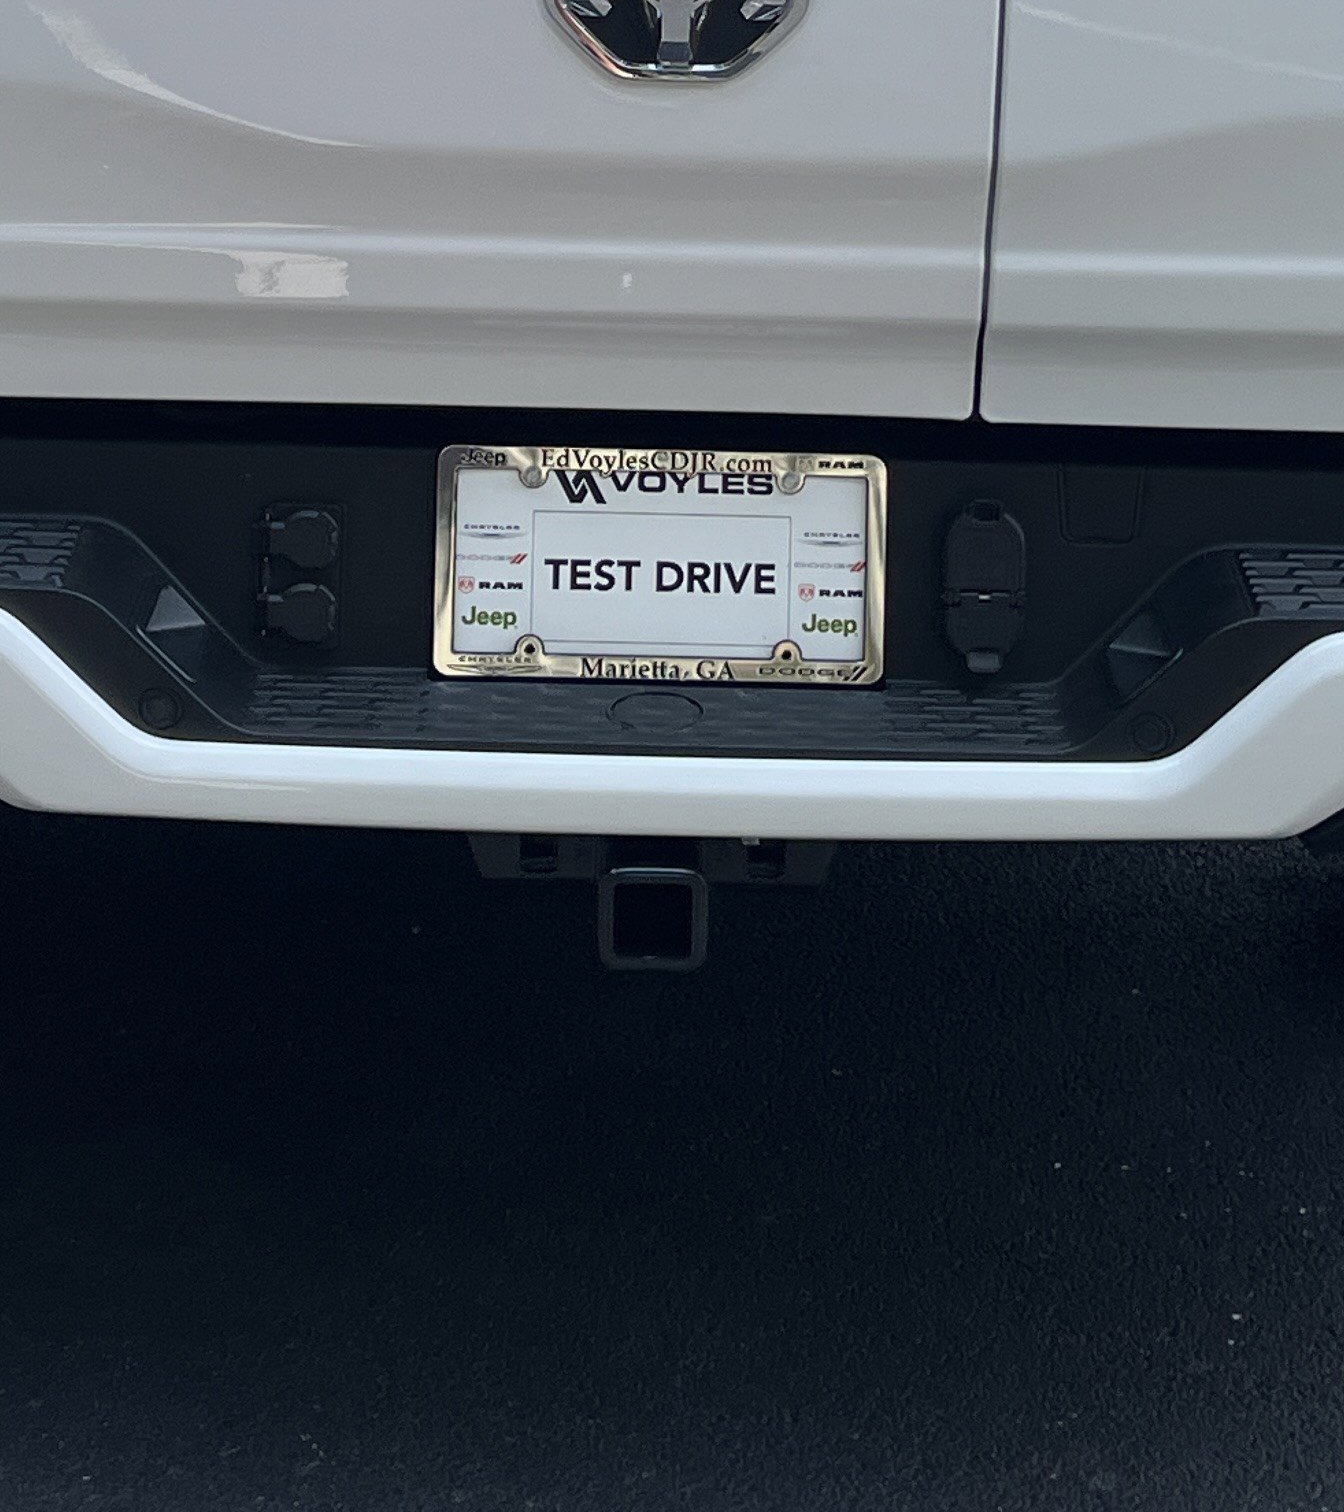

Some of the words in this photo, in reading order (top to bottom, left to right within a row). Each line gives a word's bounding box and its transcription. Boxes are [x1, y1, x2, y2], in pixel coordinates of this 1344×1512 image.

[461, 448, 509, 466] Jeep
[542, 448, 772, 477] EdVoylesCDJR.com
[818, 460, 865, 470] RAM
[610, 470, 773, 495] VOYLES
[478, 581, 524, 590] RAM
[544, 558, 642, 592] TEST
[656, 560, 776, 595] DRIVE
[818, 589, 863, 598] RAM
[461, 605, 517, 629] Jeep
[801, 613, 857, 637] Jeep
[695, 660, 735, 680] GA
